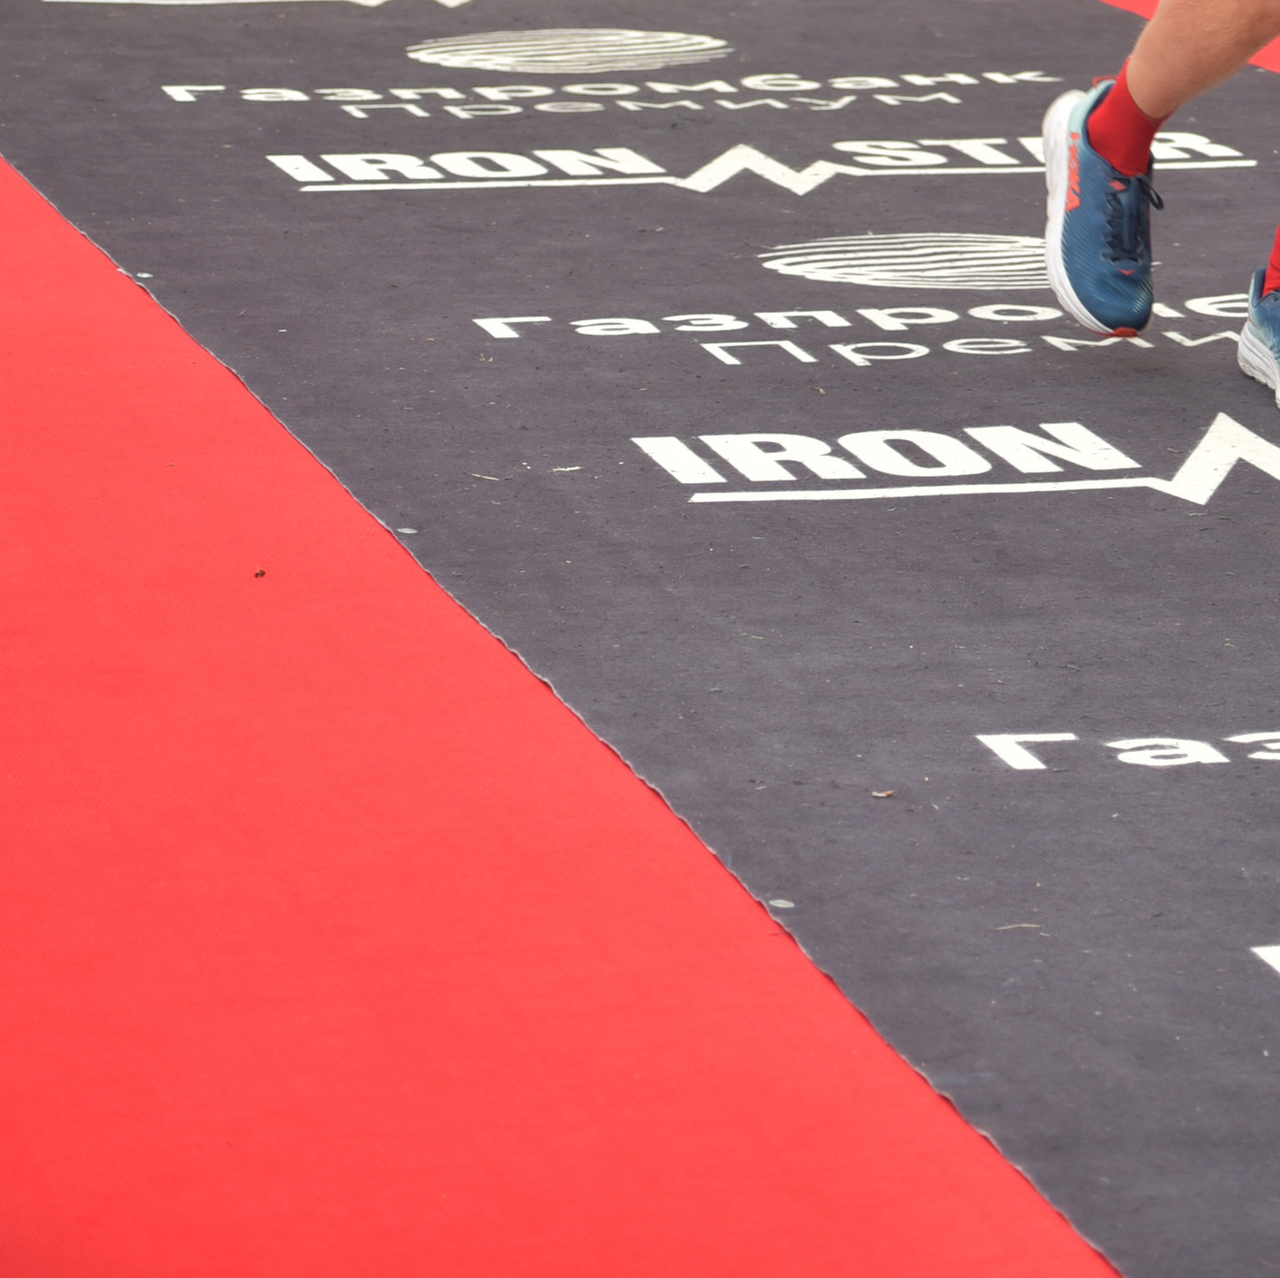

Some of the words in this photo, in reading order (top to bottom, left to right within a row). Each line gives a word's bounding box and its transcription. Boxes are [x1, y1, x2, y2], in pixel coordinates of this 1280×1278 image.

[265, 147, 668, 183] IRON
[832, 131, 1244, 167] STR
[629, 421, 1143, 485] IRON
